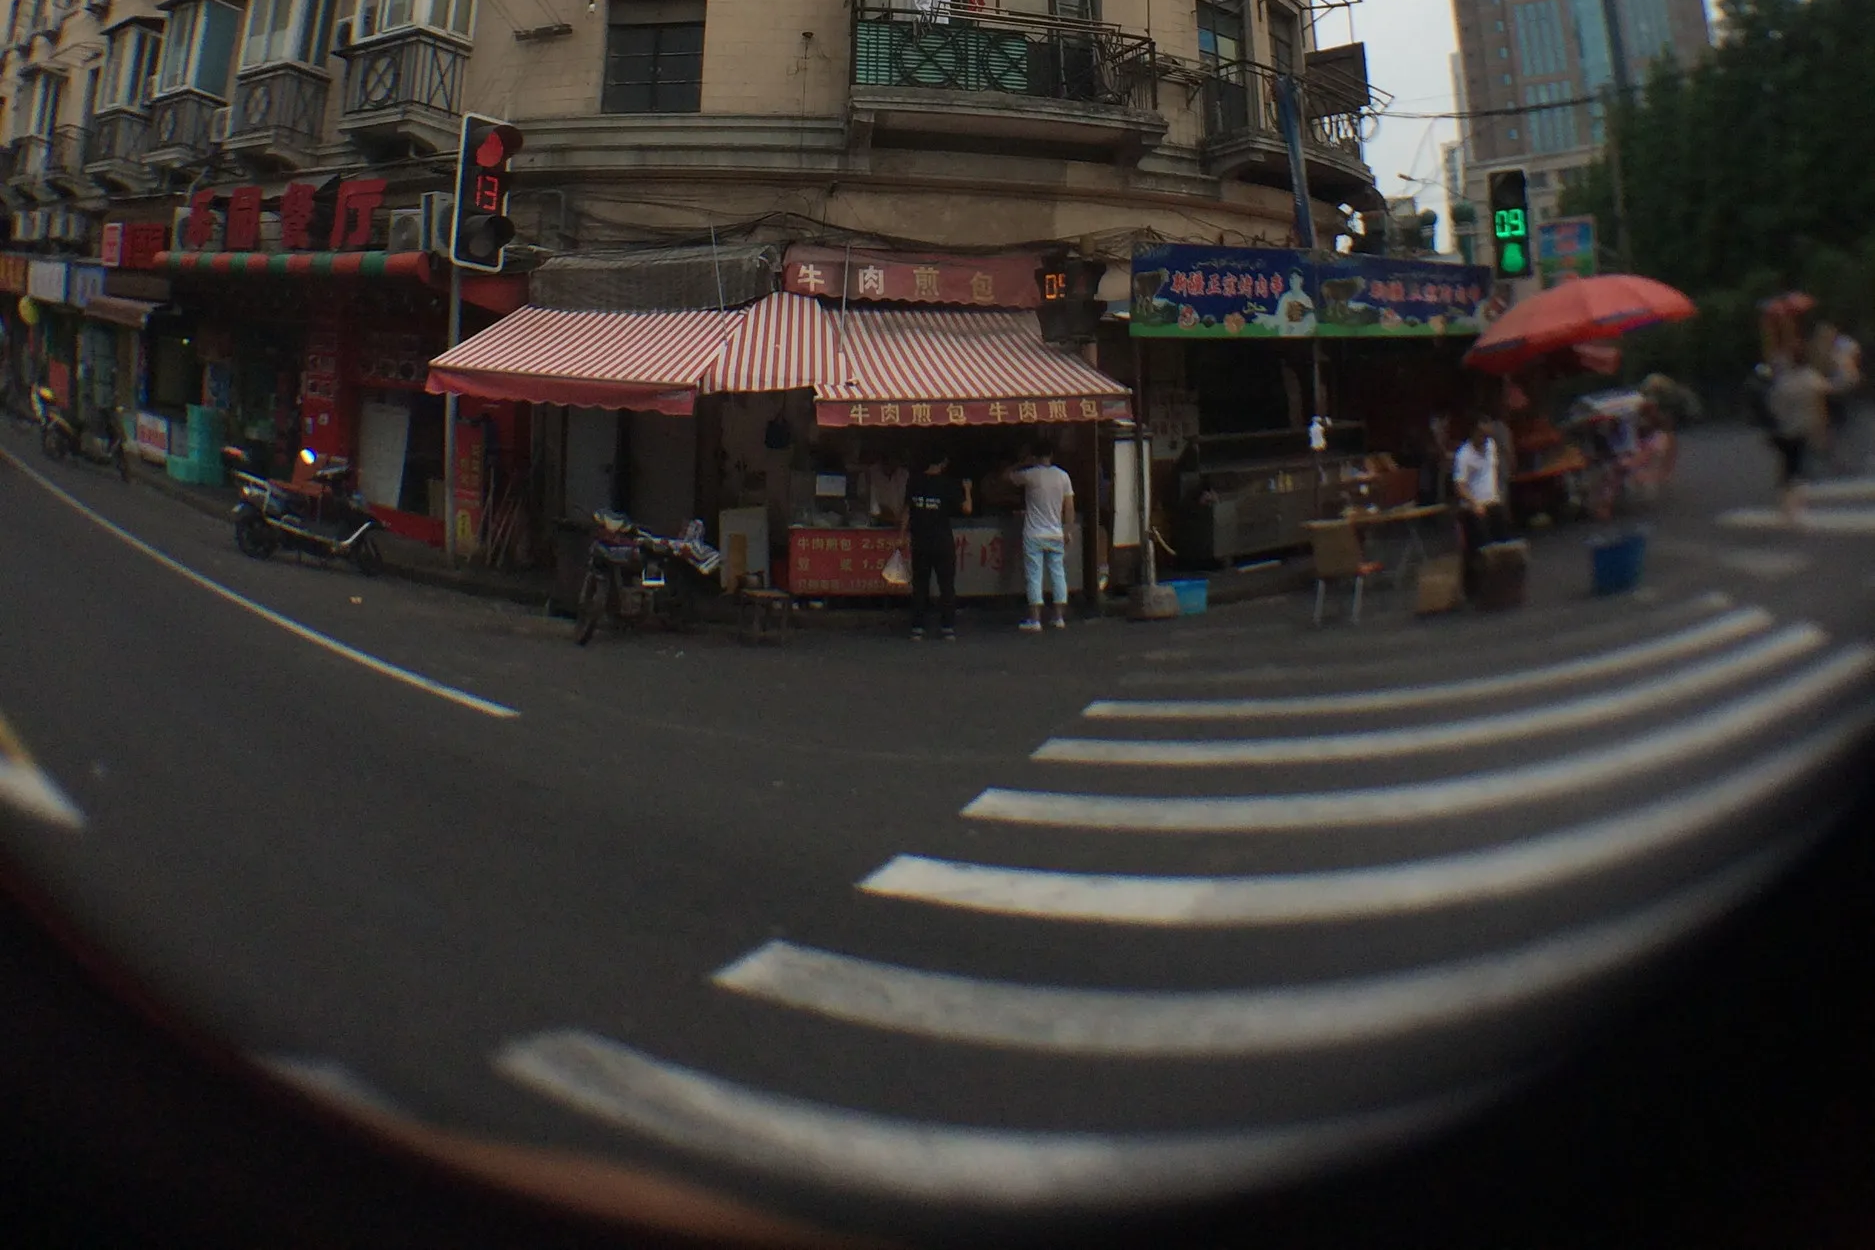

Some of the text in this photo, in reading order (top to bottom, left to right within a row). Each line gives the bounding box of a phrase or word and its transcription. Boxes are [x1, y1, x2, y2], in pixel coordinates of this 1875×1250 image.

[475, 174, 499, 211] 13
[1495, 208, 1526, 239] 09
[797, 264, 995, 300] 牛肉煎包
[850, 398, 1098, 425] 牛肉煎包 牛肉煎包
